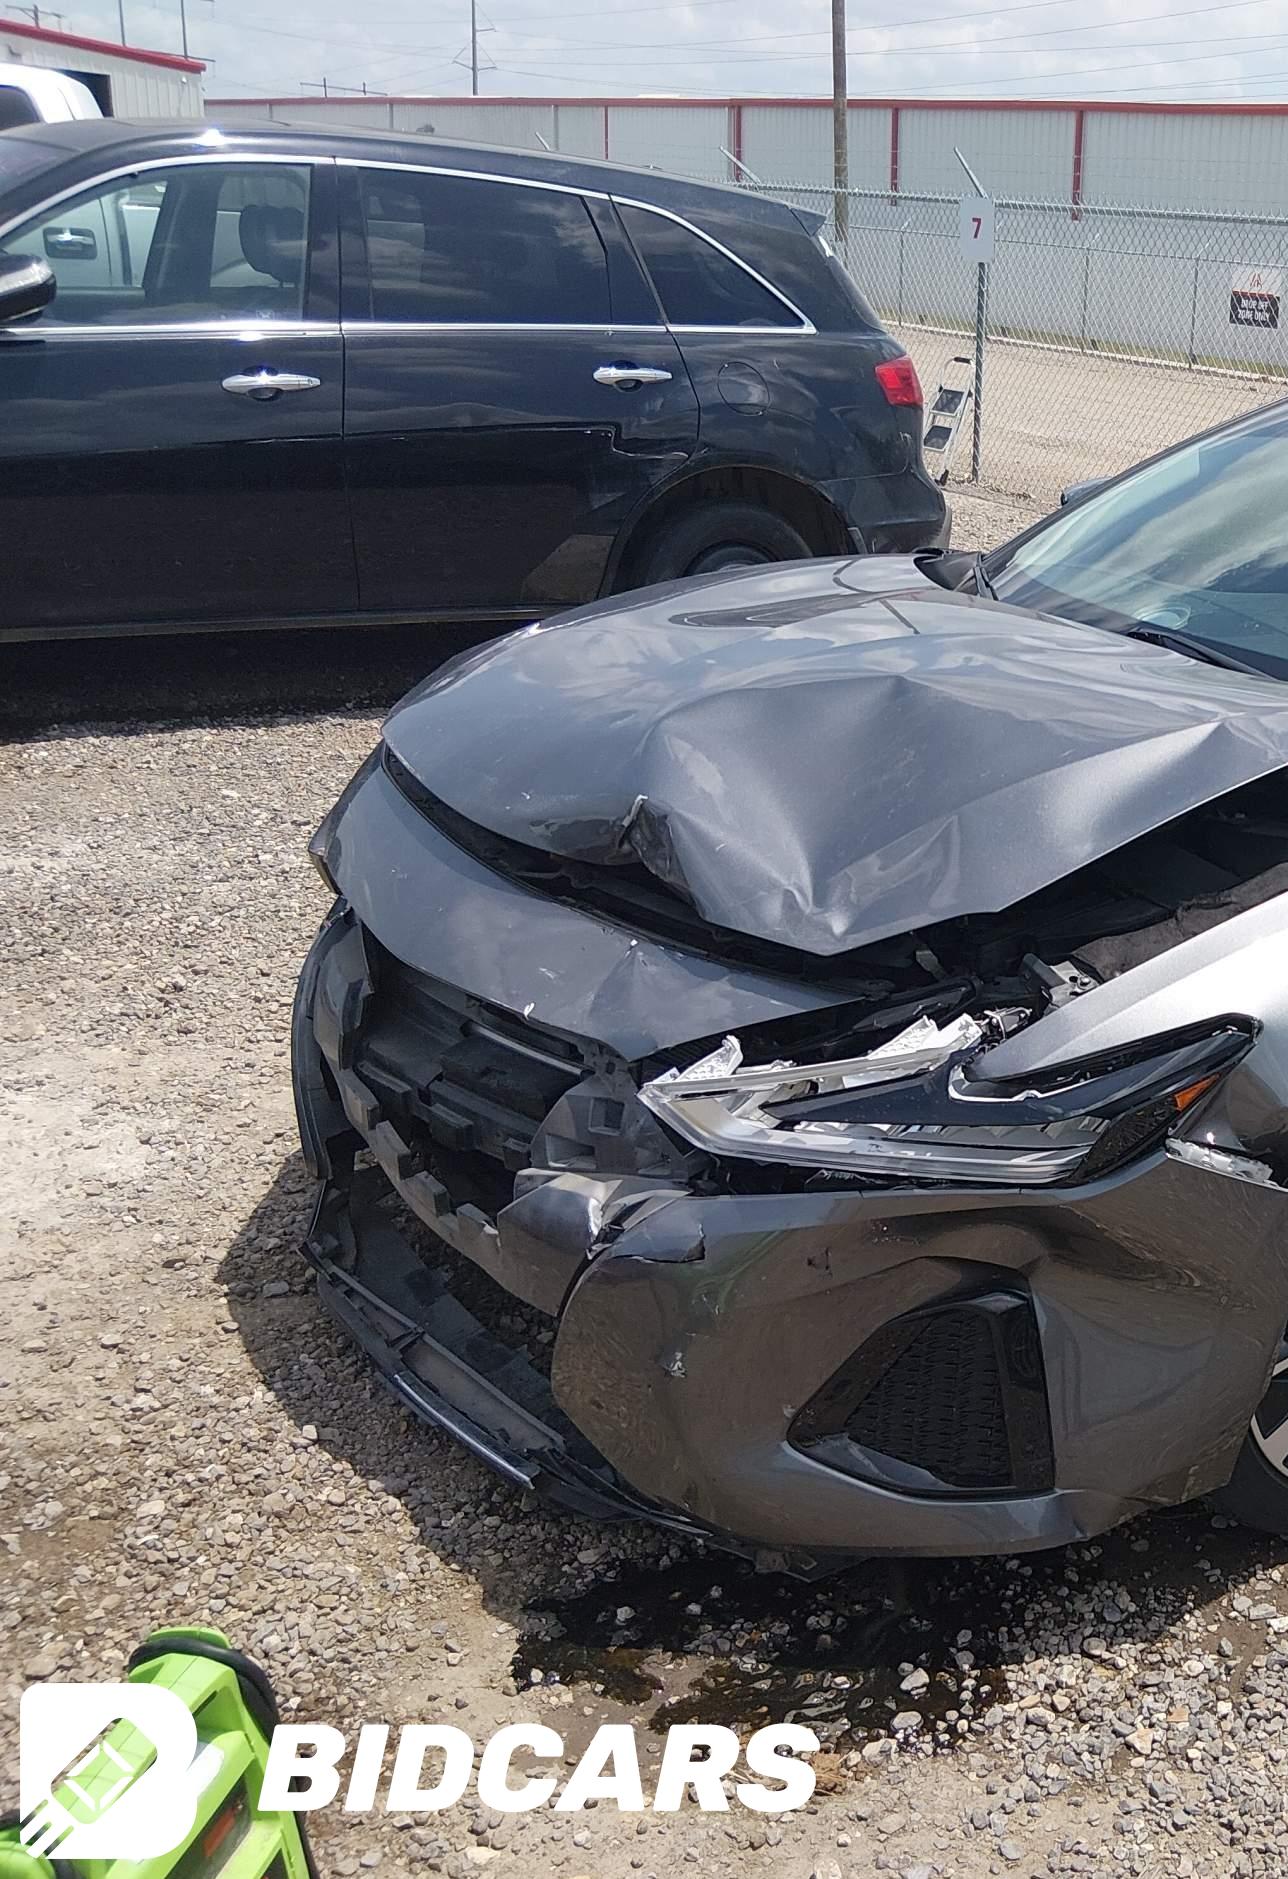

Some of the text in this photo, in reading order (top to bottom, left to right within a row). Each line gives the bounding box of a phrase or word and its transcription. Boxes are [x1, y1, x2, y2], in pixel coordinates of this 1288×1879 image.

[972, 217, 981, 239] 7
[1238, 309, 1271, 322] ZONE ONLY
